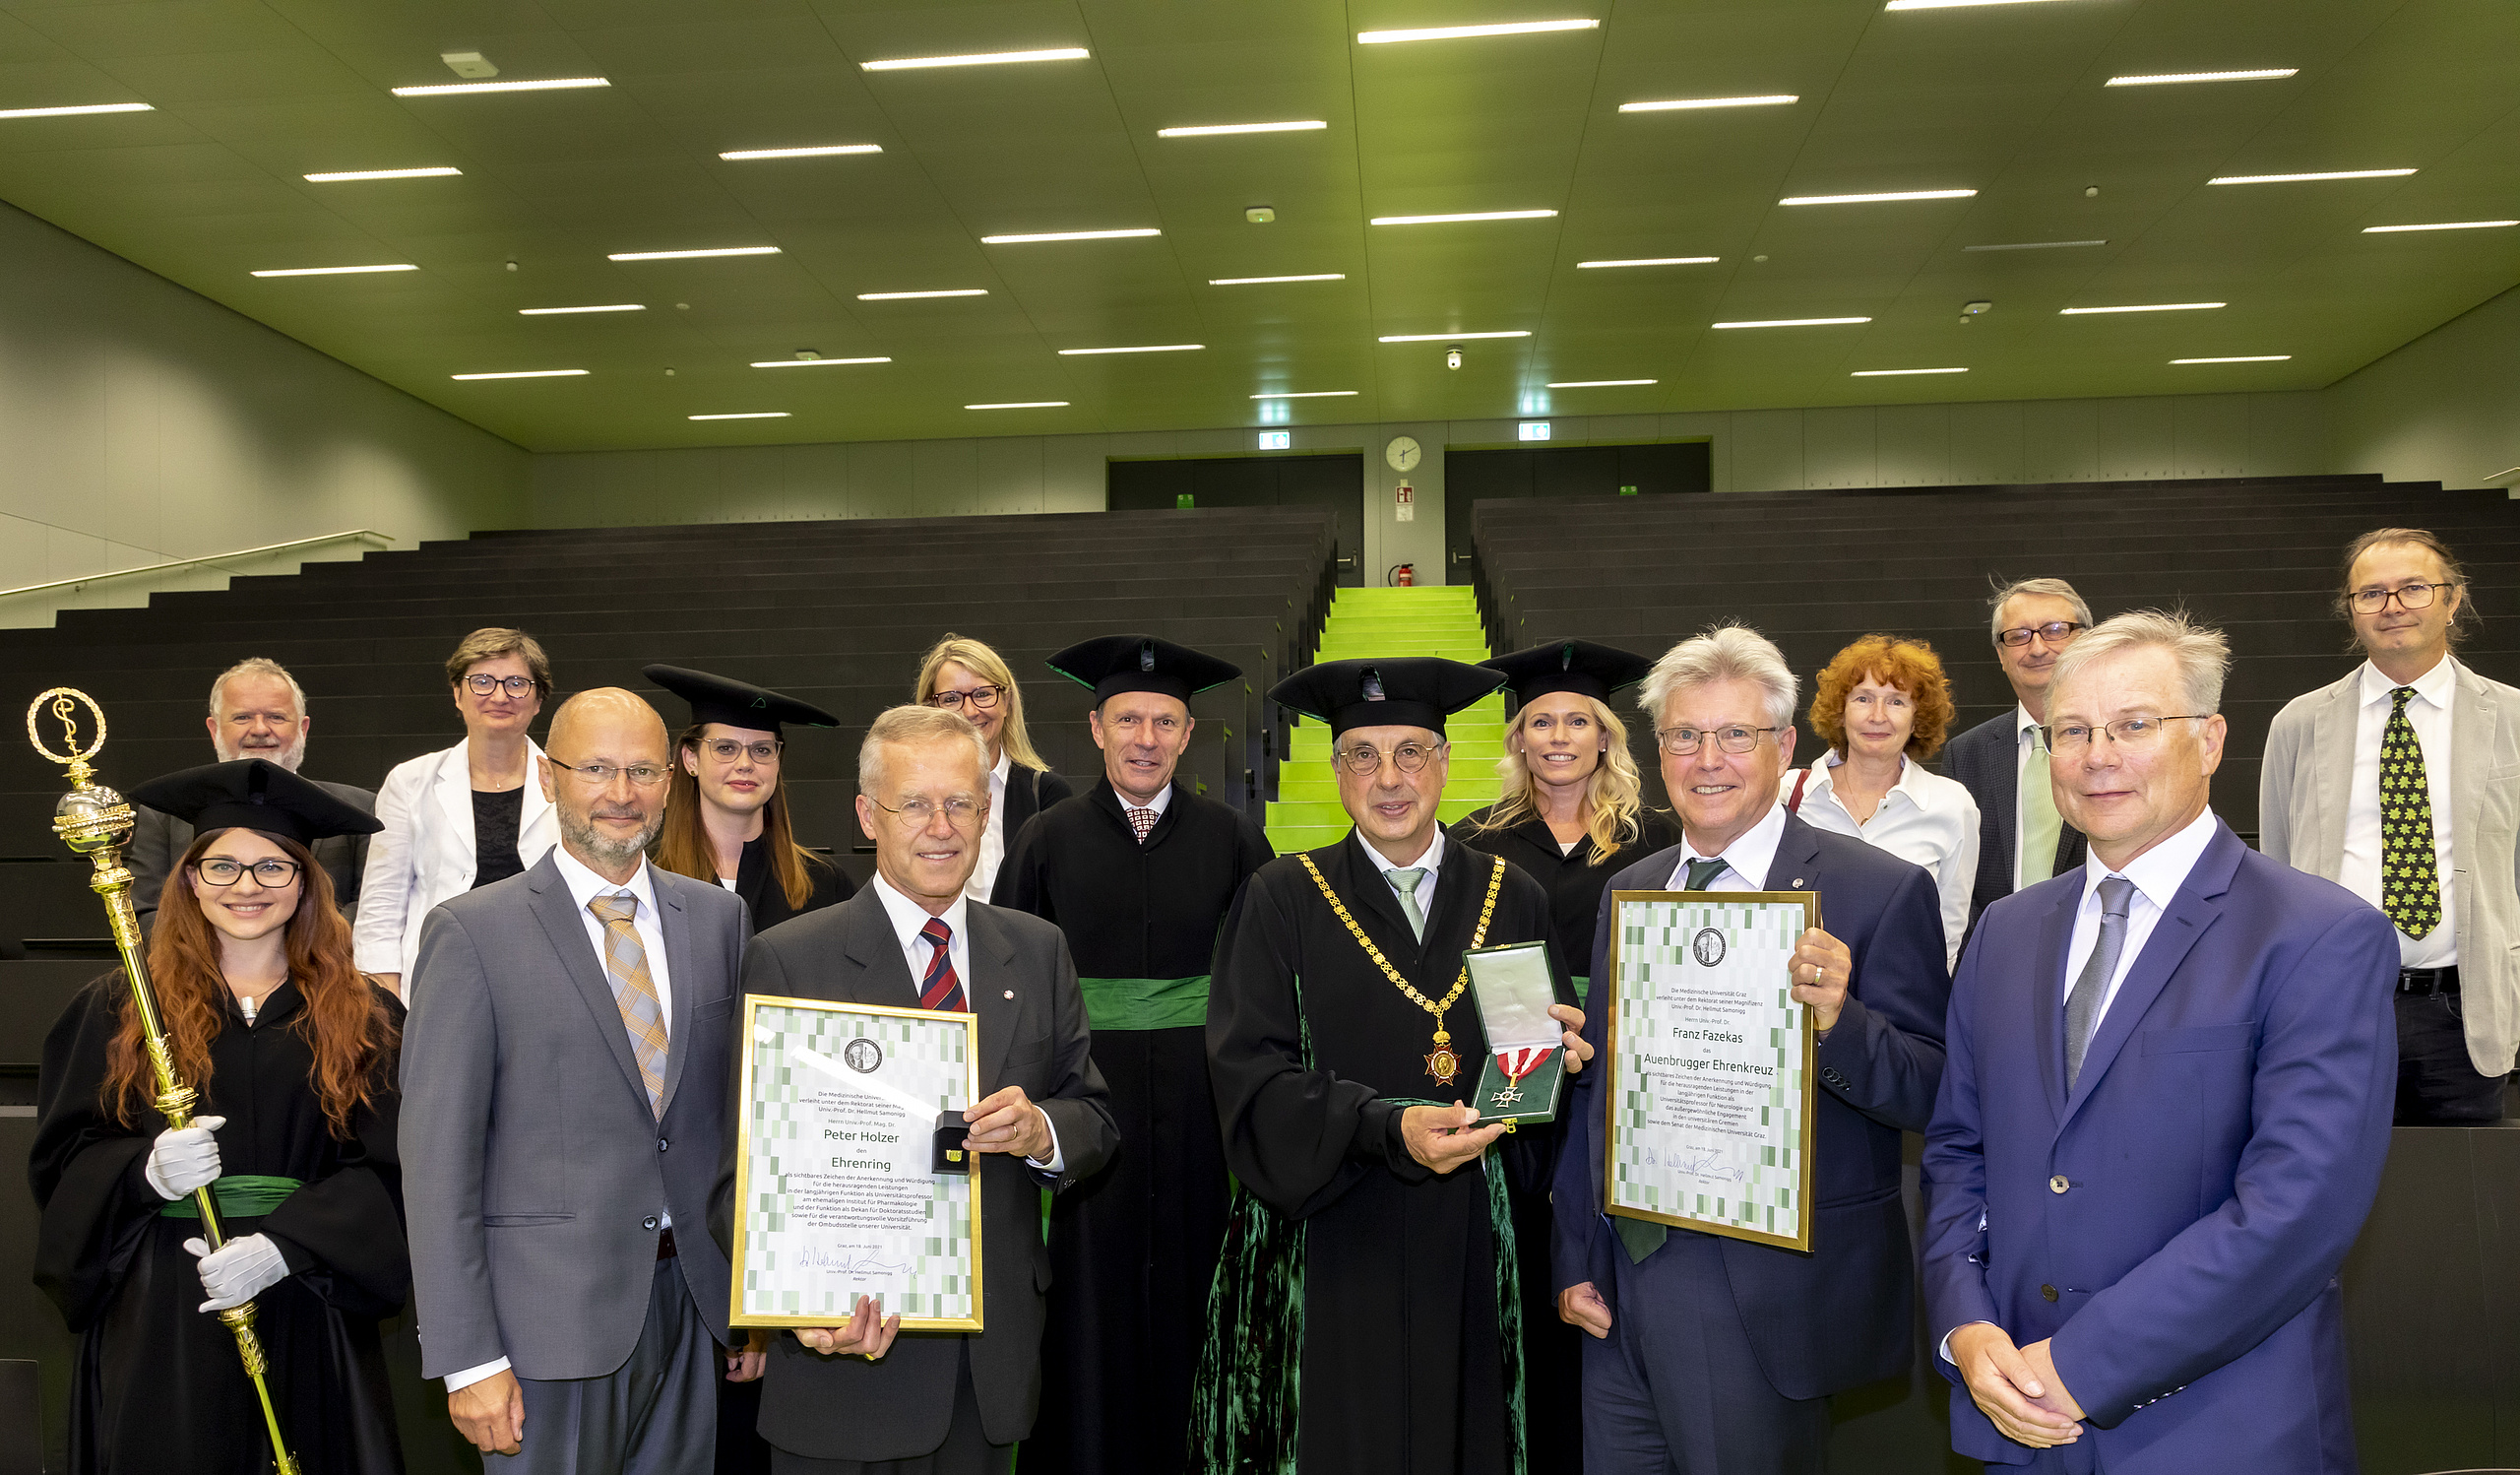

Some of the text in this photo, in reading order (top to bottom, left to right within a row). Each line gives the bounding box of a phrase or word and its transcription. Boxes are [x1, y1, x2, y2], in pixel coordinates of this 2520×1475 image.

[1672, 1027, 1742, 1043] Franz Fazekas
[1644, 1053, 1773, 1075] Auenbrugger Ehrenkreuz
[824, 1128, 899, 1143] Peter Holzer
[832, 1156, 890, 1172] Ehrenring
